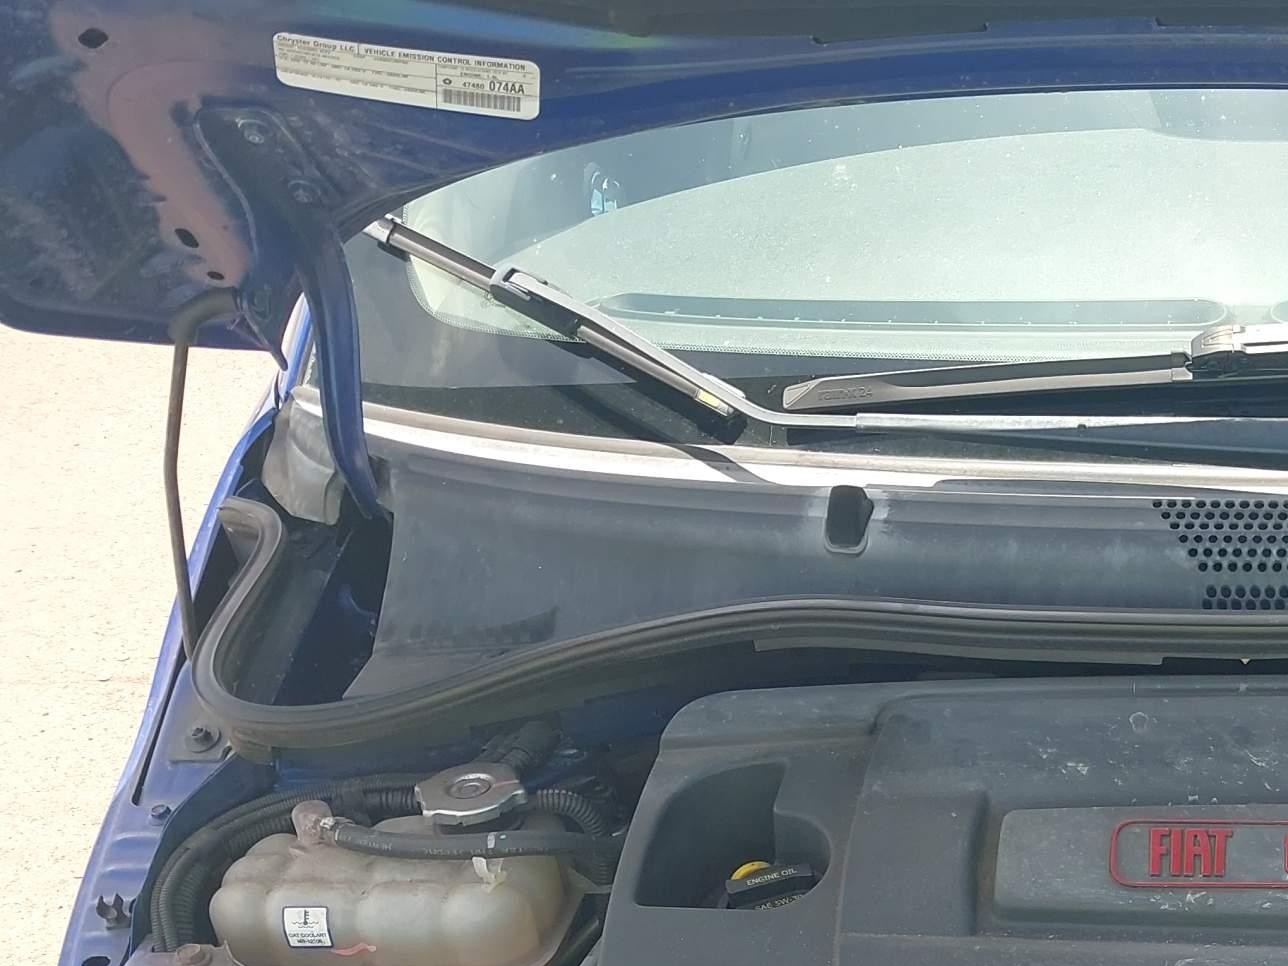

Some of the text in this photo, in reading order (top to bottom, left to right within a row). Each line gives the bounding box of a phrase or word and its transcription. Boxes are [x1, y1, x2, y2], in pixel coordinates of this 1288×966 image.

[313, 41, 337, 50] Group
[340, 43, 354, 52] LLC
[364, 47, 395, 57] VEHICLE
[399, 51, 434, 62] EMISSION
[437, 56, 471, 66] CONTROL
[474, 60, 526, 71] INFORMATION
[489, 80, 525, 94] 074AA
[1148, 827, 1234, 877] FIAT
[746, 868, 798, 886] ENGINE OIL
